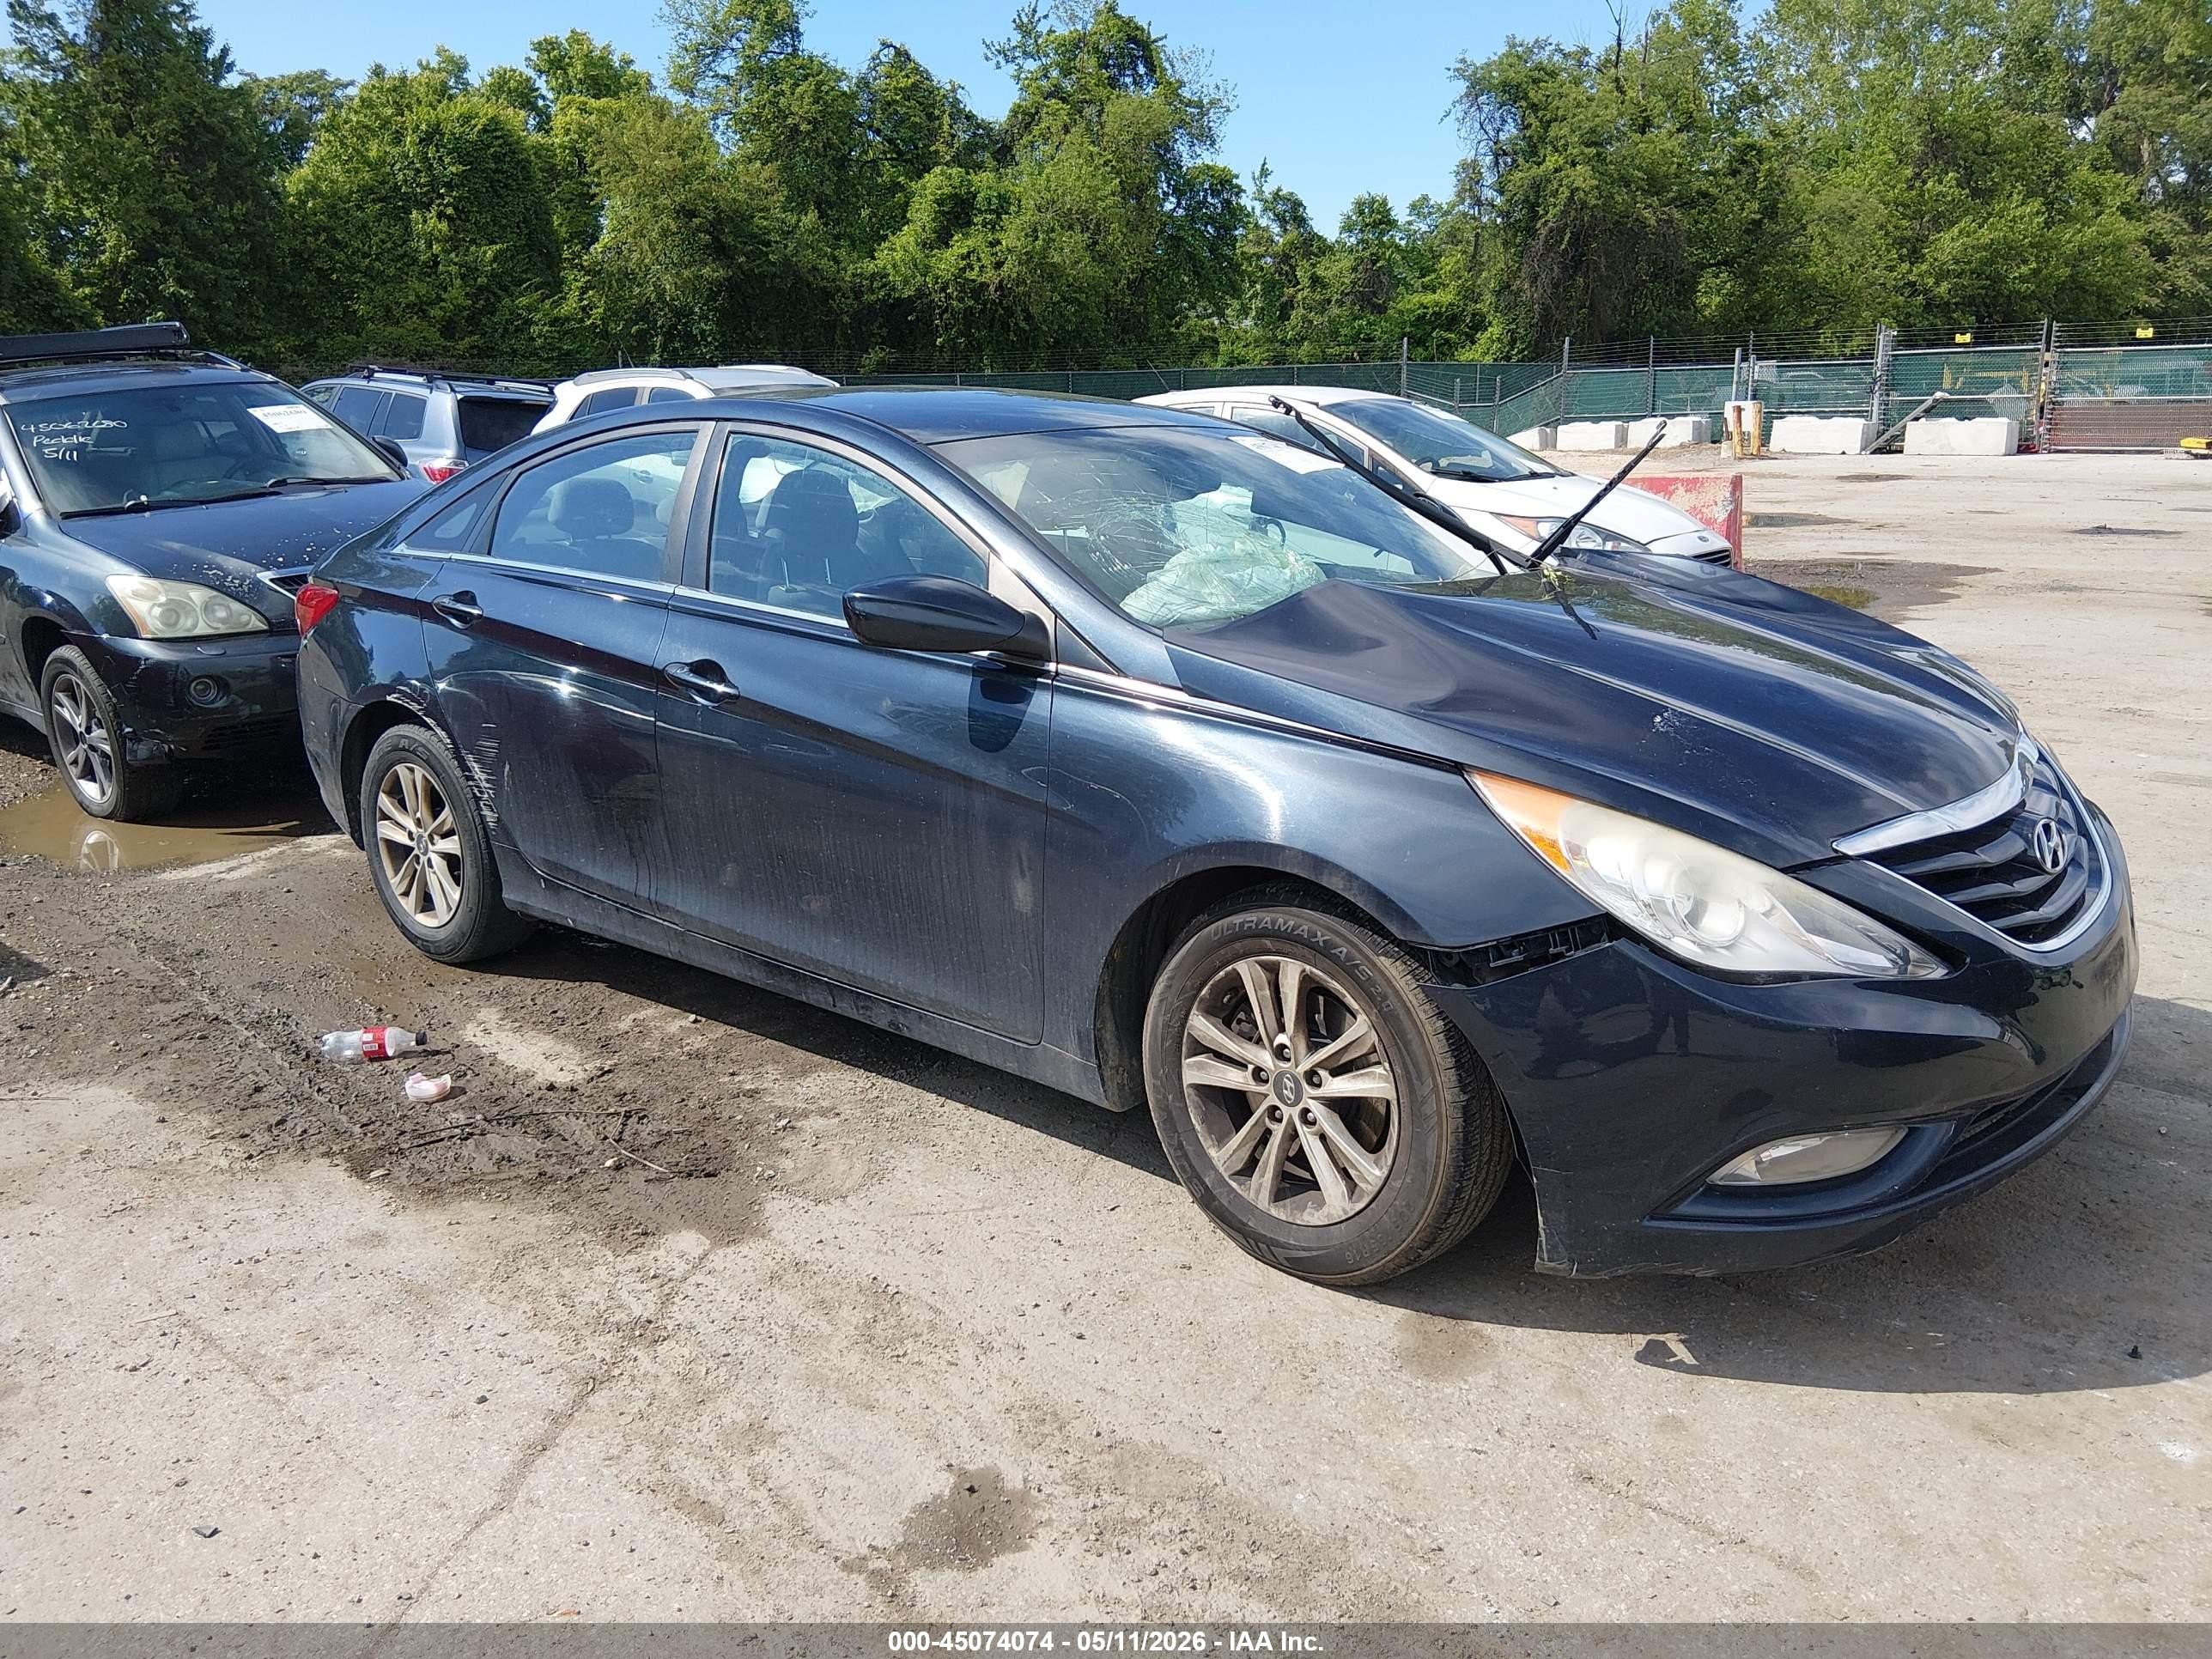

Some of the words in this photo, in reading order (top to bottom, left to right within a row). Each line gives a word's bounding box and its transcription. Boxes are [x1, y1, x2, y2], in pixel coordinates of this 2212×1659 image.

[42, 447, 78, 461] 5/11
[1211, 915, 1331, 946] ULTRAMAX
[1331, 946, 1374, 981] A/S
